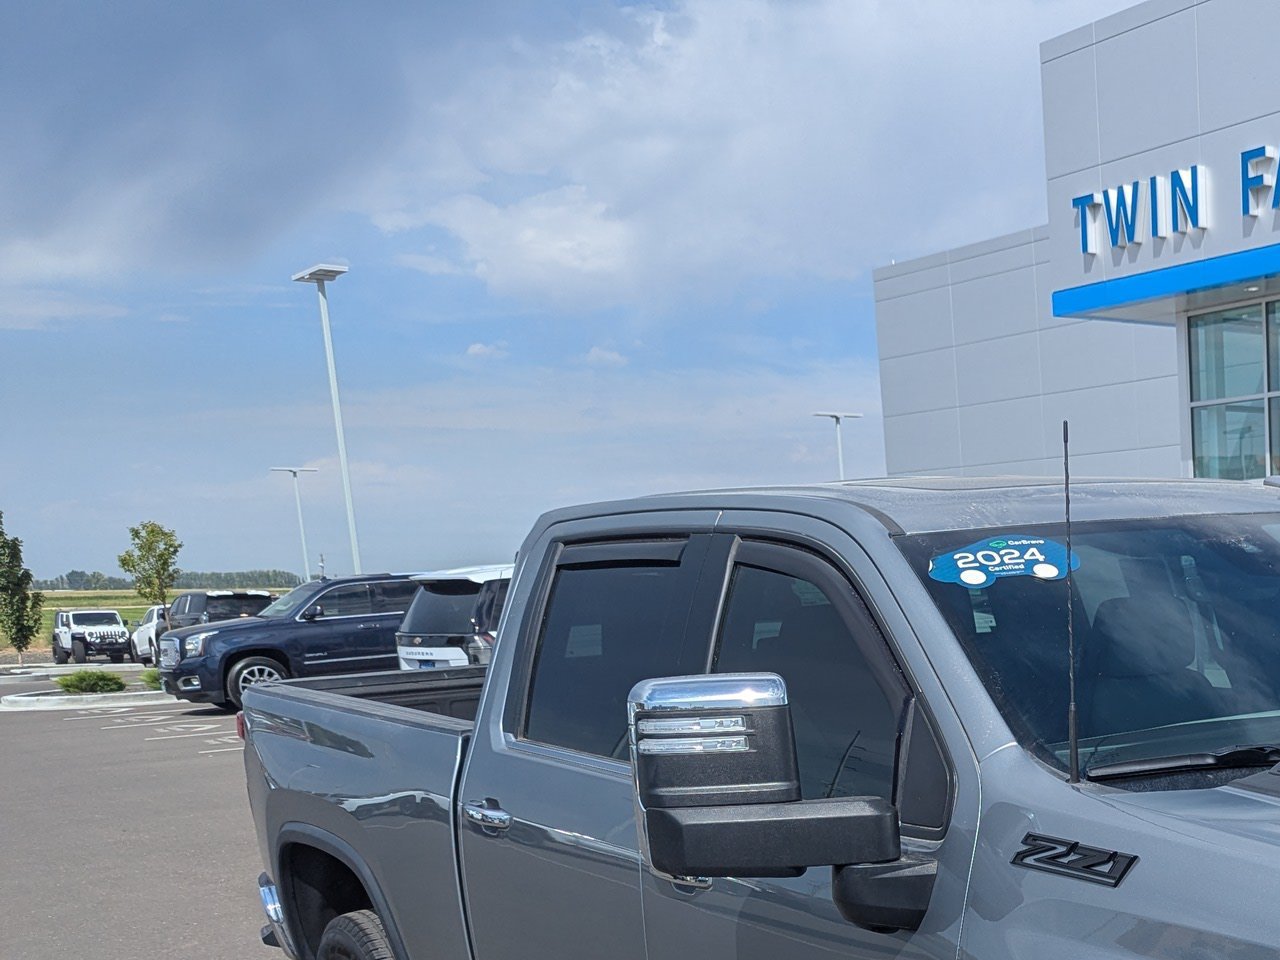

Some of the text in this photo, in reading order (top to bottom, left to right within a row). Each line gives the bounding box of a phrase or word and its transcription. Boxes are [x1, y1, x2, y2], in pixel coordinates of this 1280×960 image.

[1072, 165, 1207, 255] TWIN
[953, 547, 1046, 569] 2024
[988, 563, 1025, 573] Certified
[1009, 831, 1141, 888] Z71
